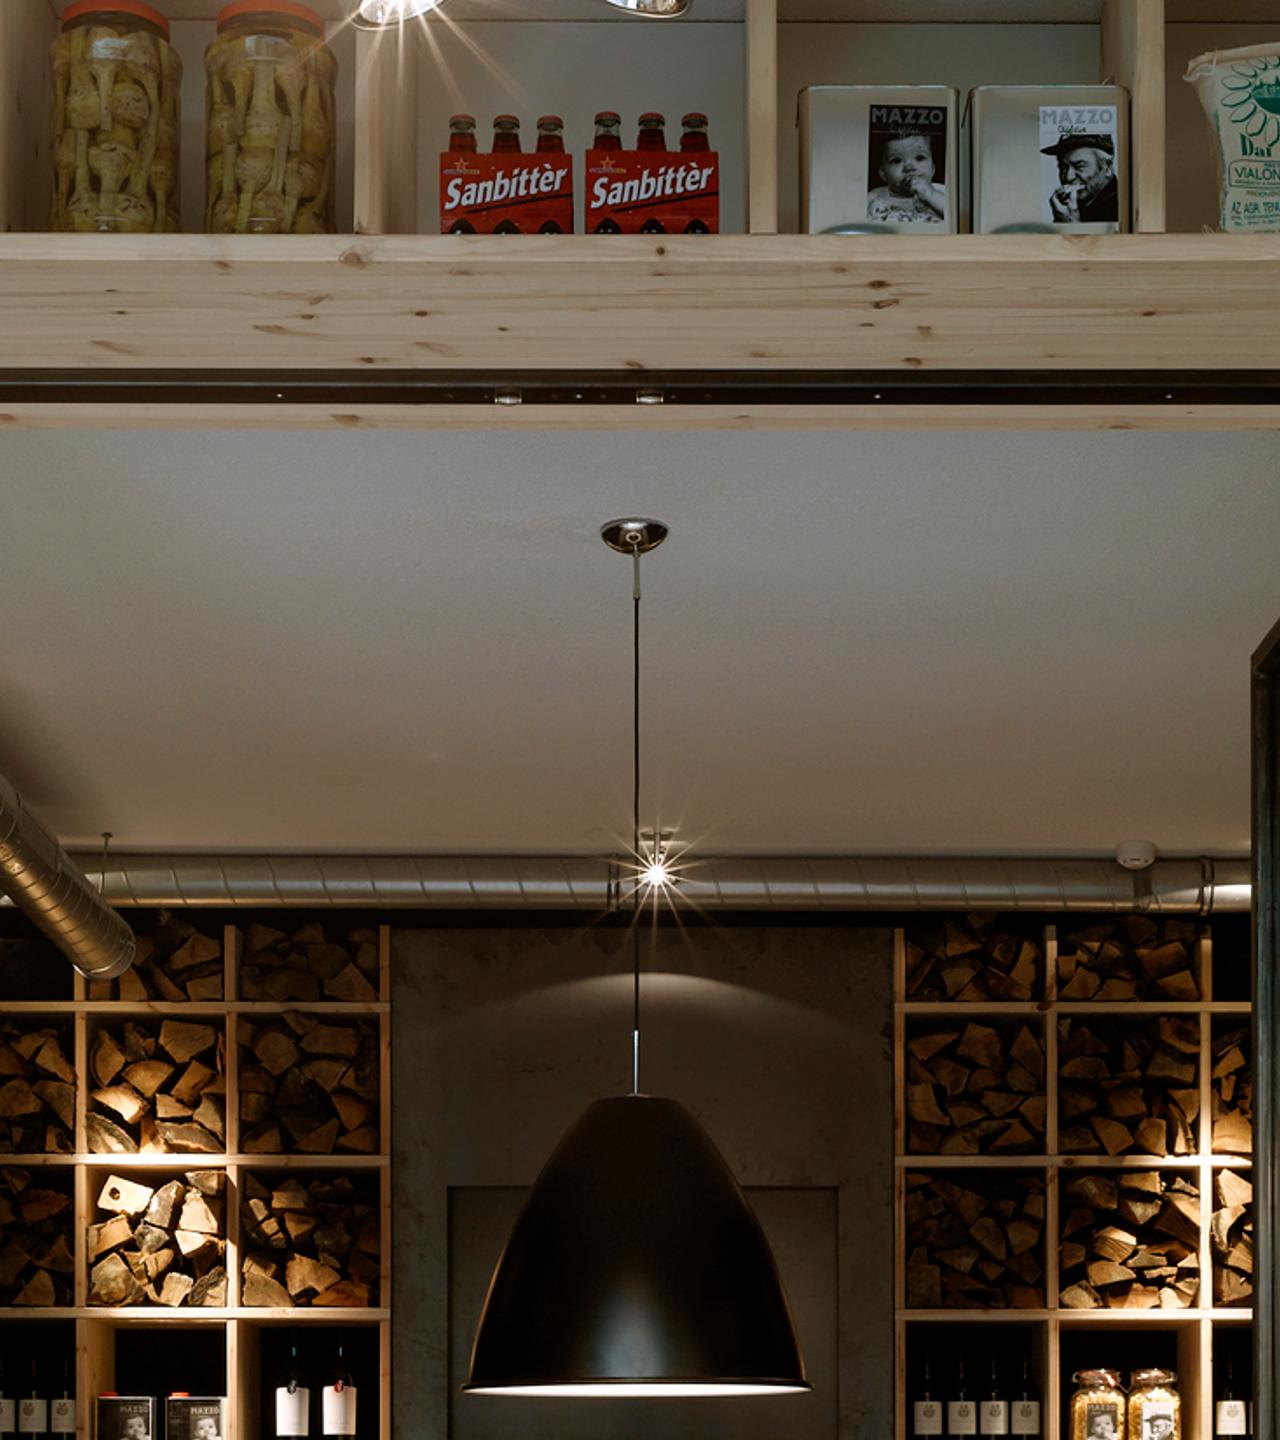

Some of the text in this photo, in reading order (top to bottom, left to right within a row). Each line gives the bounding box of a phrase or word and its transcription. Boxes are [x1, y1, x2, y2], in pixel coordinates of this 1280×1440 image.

[871, 107, 944, 125] MAZZO
[1042, 109, 1113, 126] MAZZO
[443, 163, 569, 212] Sanbittèr
[590, 161, 715, 210] Sanbittèr
[190, 1406, 220, 1415] MAZZO
